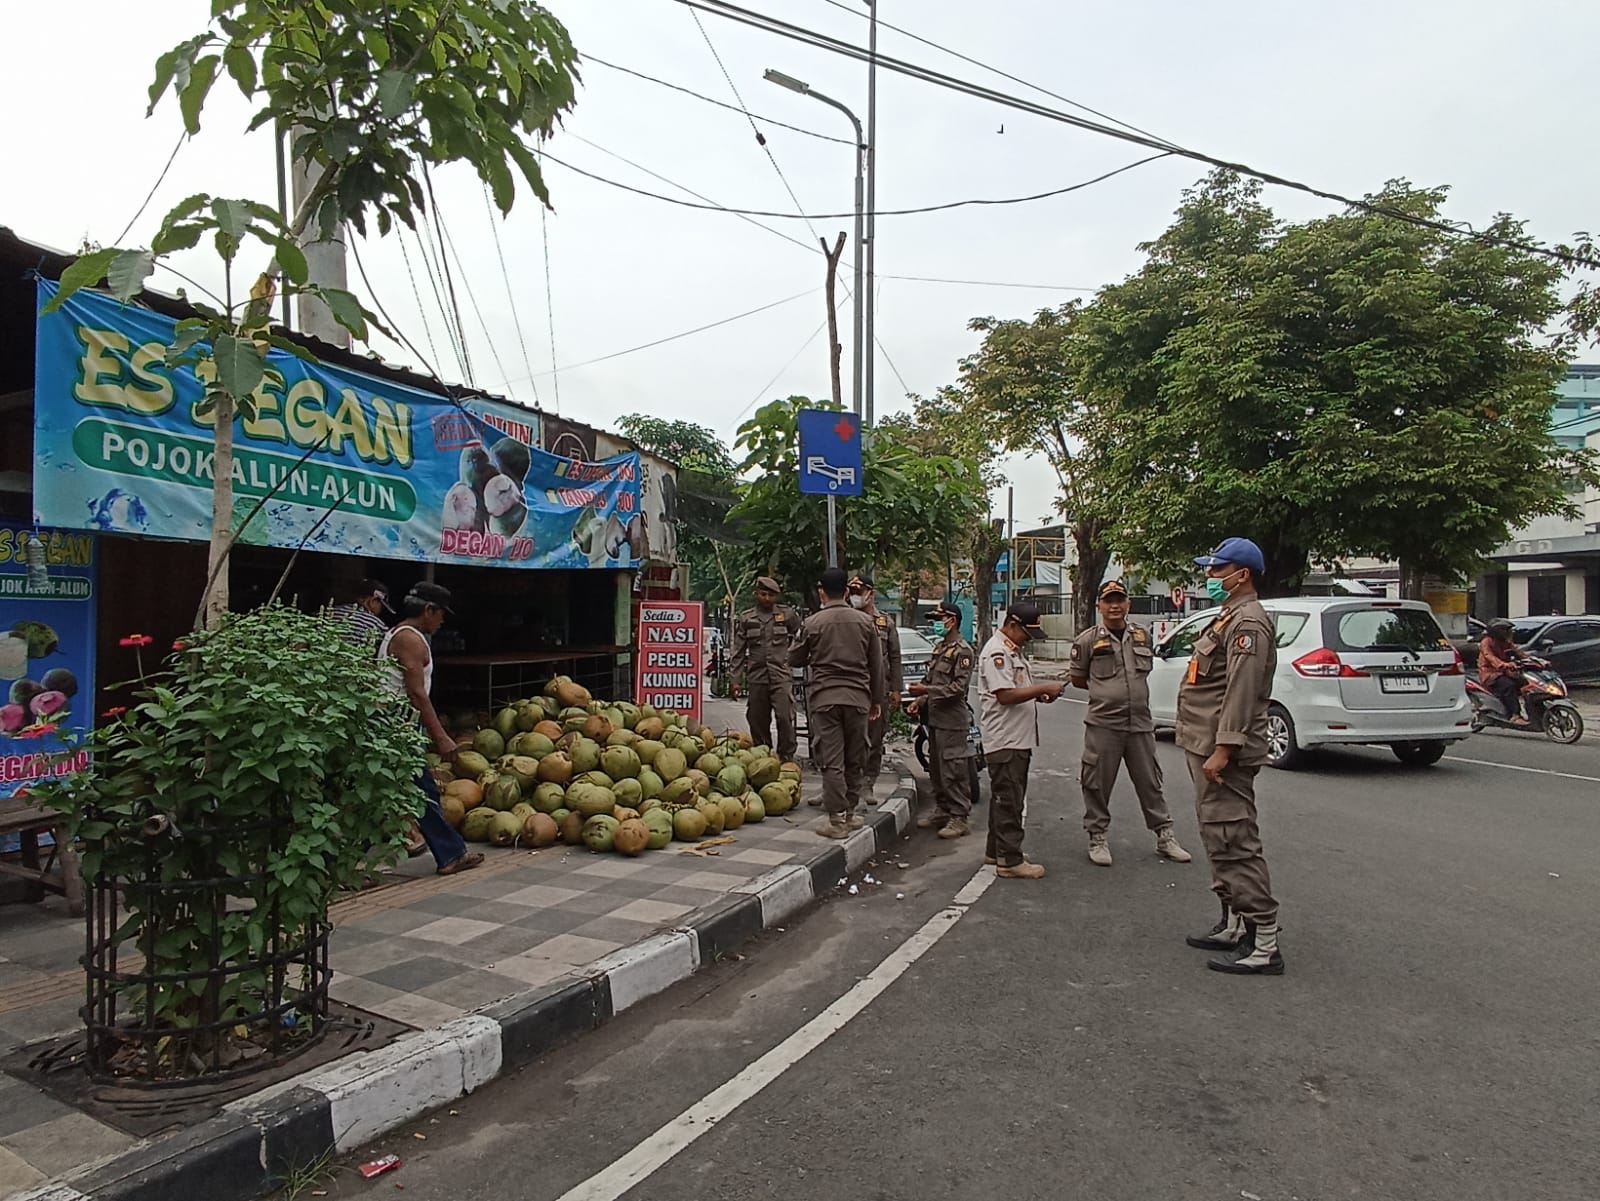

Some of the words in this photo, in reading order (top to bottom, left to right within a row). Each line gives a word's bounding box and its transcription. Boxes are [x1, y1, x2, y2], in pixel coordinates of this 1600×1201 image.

[75, 326, 174, 413] ES
[102, 432, 216, 481] POJOK
[231, 456, 397, 513] ALUN-ALUN
[441, 528, 506, 559] DEGAN
[643, 609, 675, 622] Sedia
[647, 626, 695, 643] NASI
[647, 652, 694, 668] PECEL
[642, 673, 697, 688] KUNING
